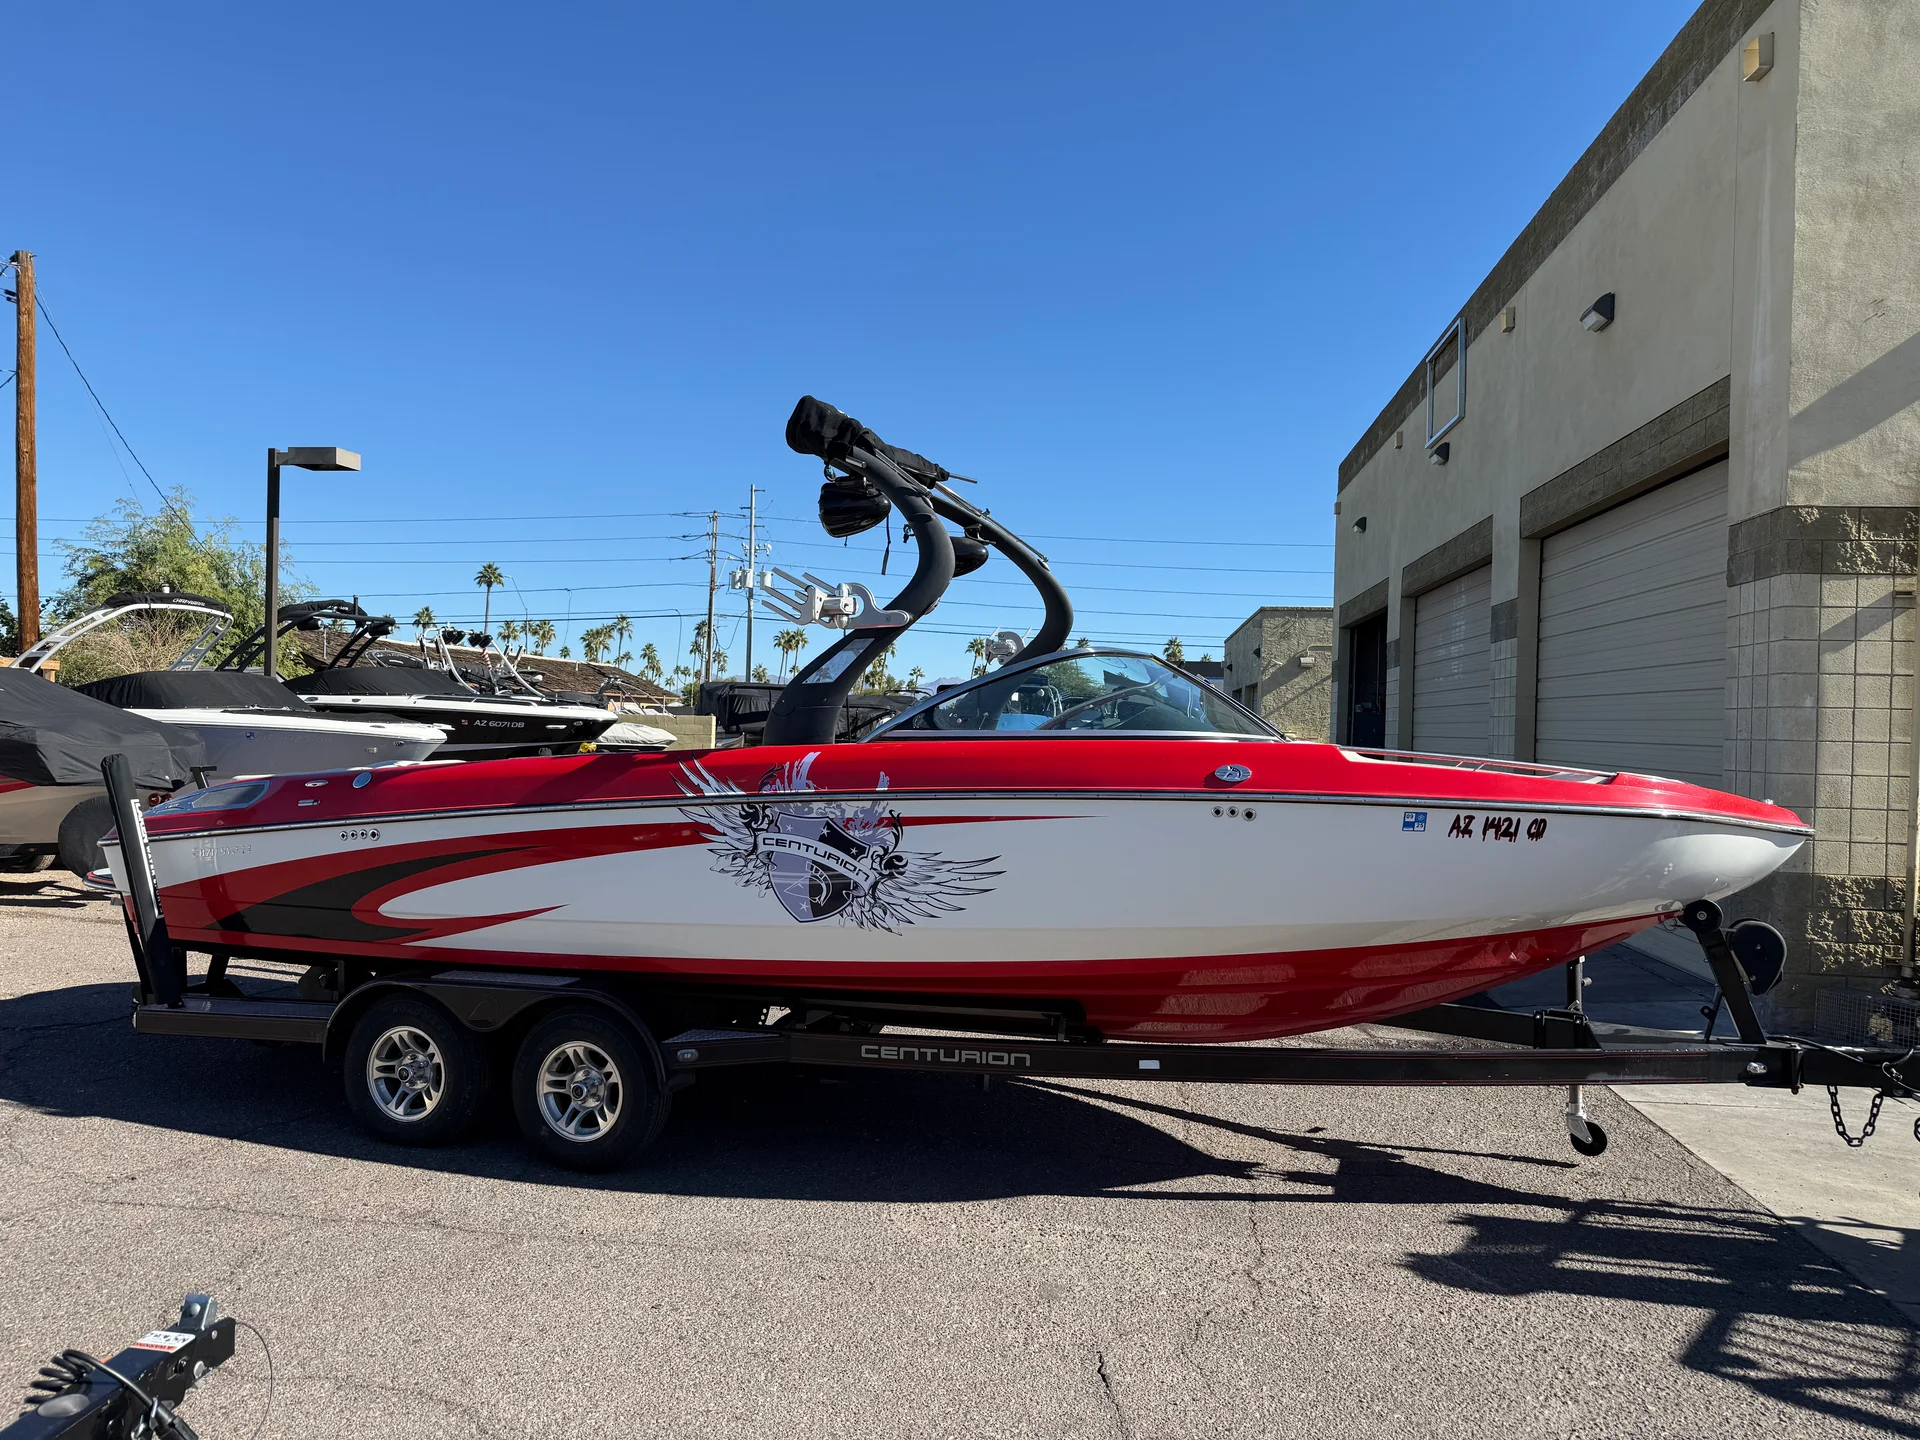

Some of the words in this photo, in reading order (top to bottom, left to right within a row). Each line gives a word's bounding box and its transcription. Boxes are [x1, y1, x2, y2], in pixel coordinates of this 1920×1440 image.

[1447, 813, 1476, 839] AZ
[1482, 815, 1521, 843] 1421
[762, 836, 872, 882] CENTURION
[861, 1045, 1031, 1067] CENTURION
